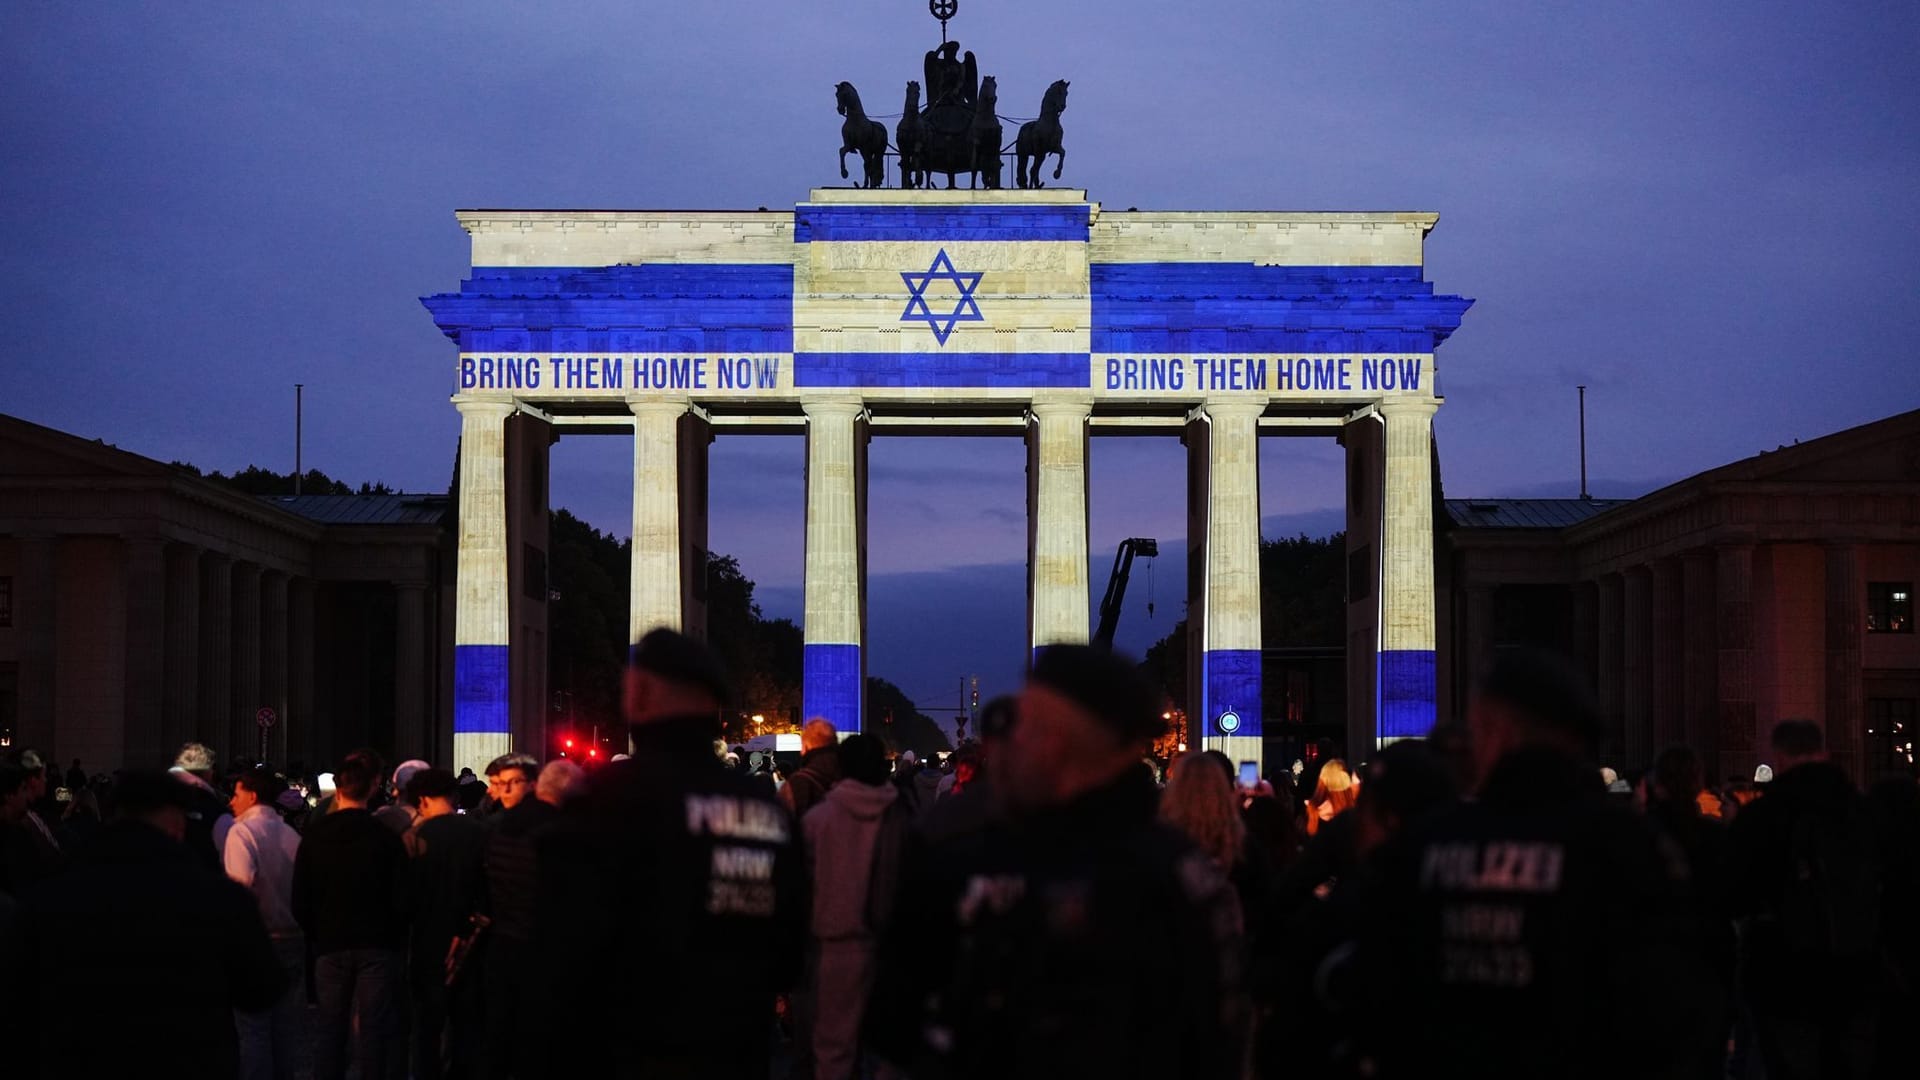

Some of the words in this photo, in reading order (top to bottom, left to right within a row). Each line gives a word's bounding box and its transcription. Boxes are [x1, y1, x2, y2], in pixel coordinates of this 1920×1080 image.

[461, 358, 541, 389] BRING
[550, 358, 623, 389] THEM
[633, 358, 707, 389] HOME
[718, 358, 780, 389] NOW
[1106, 358, 1184, 390] BRING
[1193, 359, 1267, 390] THEM
[1277, 359, 1352, 390] HOME
[1362, 359, 1421, 390] NOW
[1419, 841, 1566, 892] POLIZEI
